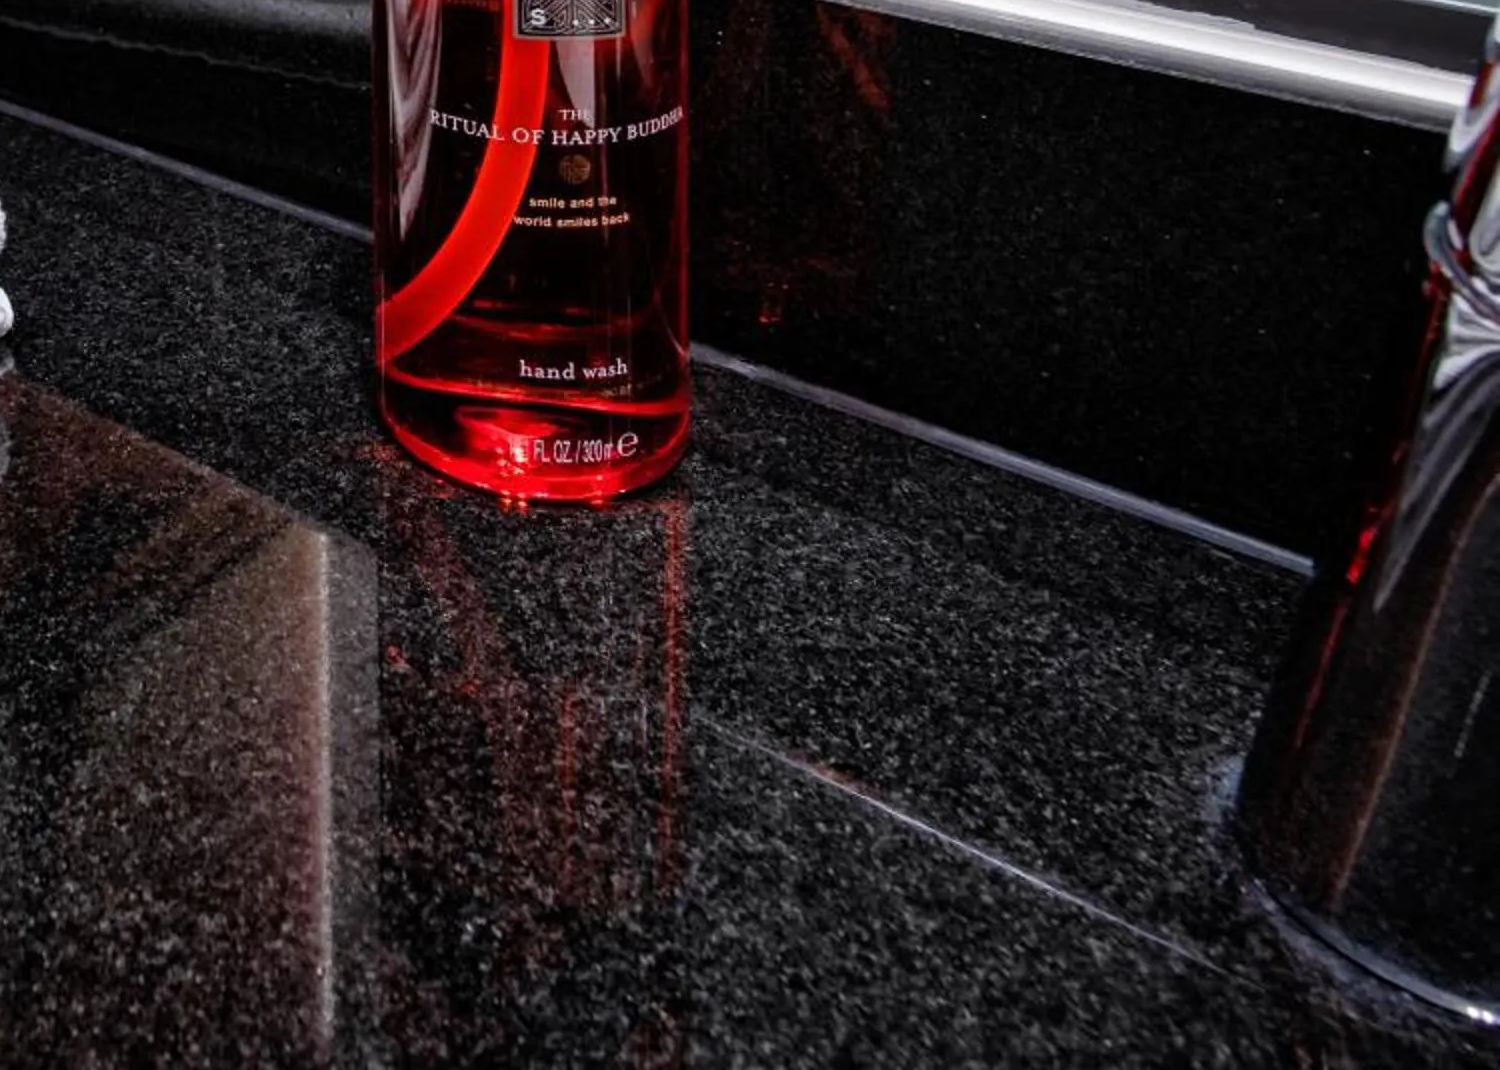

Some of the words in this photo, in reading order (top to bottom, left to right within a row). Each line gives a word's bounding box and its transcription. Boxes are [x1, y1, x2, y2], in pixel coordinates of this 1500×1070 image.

[430, 108, 505, 142] RITUAL
[511, 126, 545, 146] OF
[551, 127, 623, 146] HAPPY
[529, 196, 565, 209] smile
[569, 196, 595, 209] and
[597, 195, 617, 207] the
[513, 214, 552, 227] world
[556, 216, 599, 228] smiles
[601, 211, 630, 226] back
[519, 359, 575, 380] hand
[582, 357, 629, 380] wash
